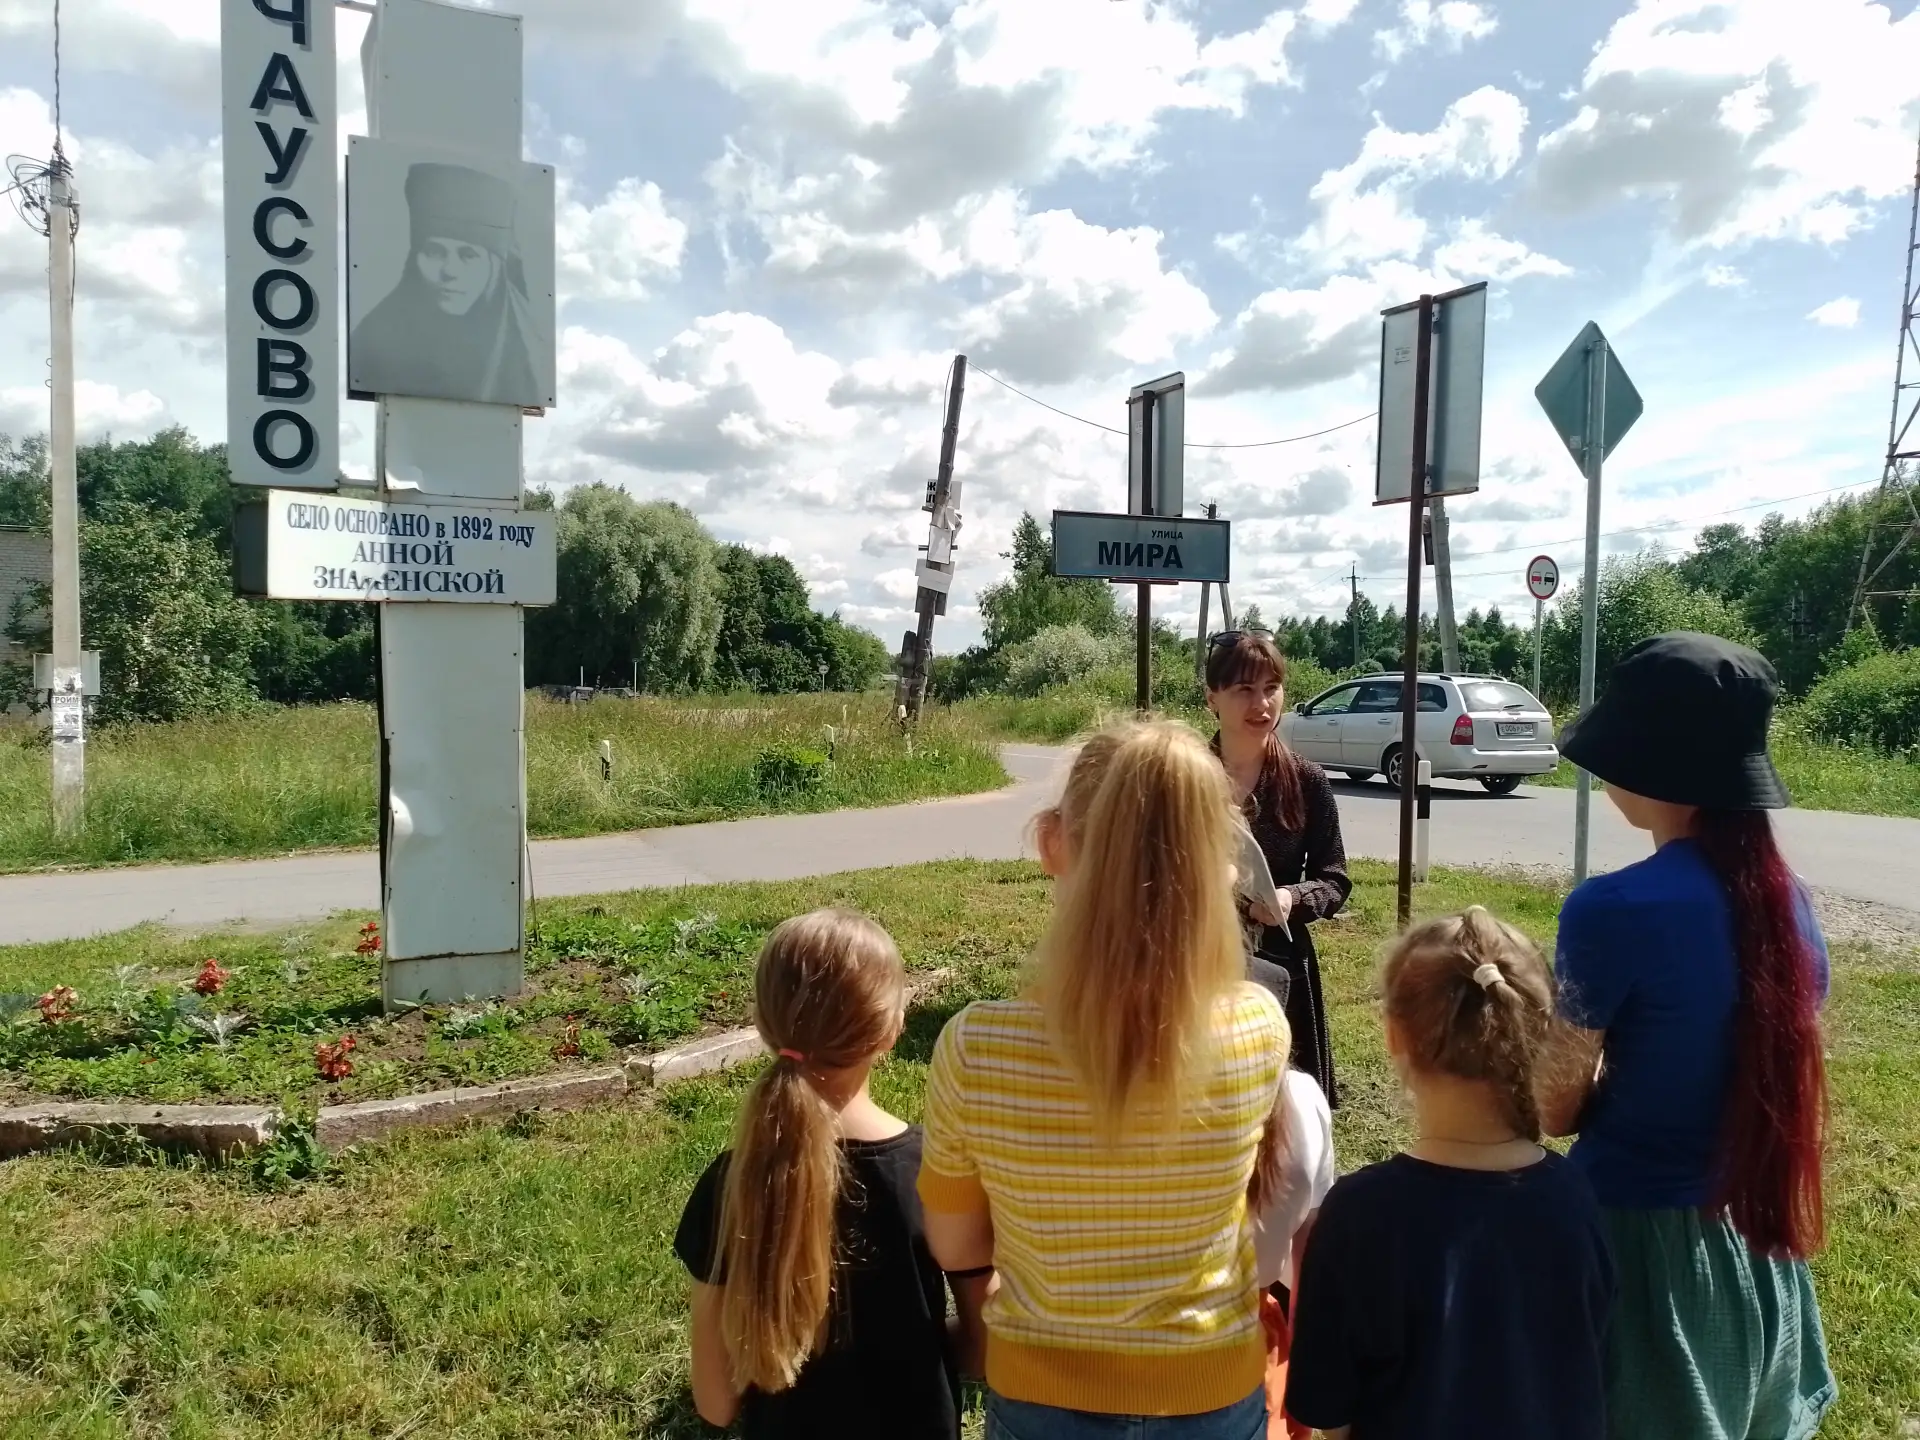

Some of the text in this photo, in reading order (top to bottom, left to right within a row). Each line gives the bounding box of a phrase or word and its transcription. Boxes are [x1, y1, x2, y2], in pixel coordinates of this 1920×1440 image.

[251, 0, 314, 469] ЧАУСОВО
[287, 502, 535, 548] СЕЛО ОСНОВАНО в 1892 году
[1151, 529, 1184, 540] УЛИЦА
[352, 540, 455, 566] АННОЙ
[1098, 541, 1184, 569] МИРА
